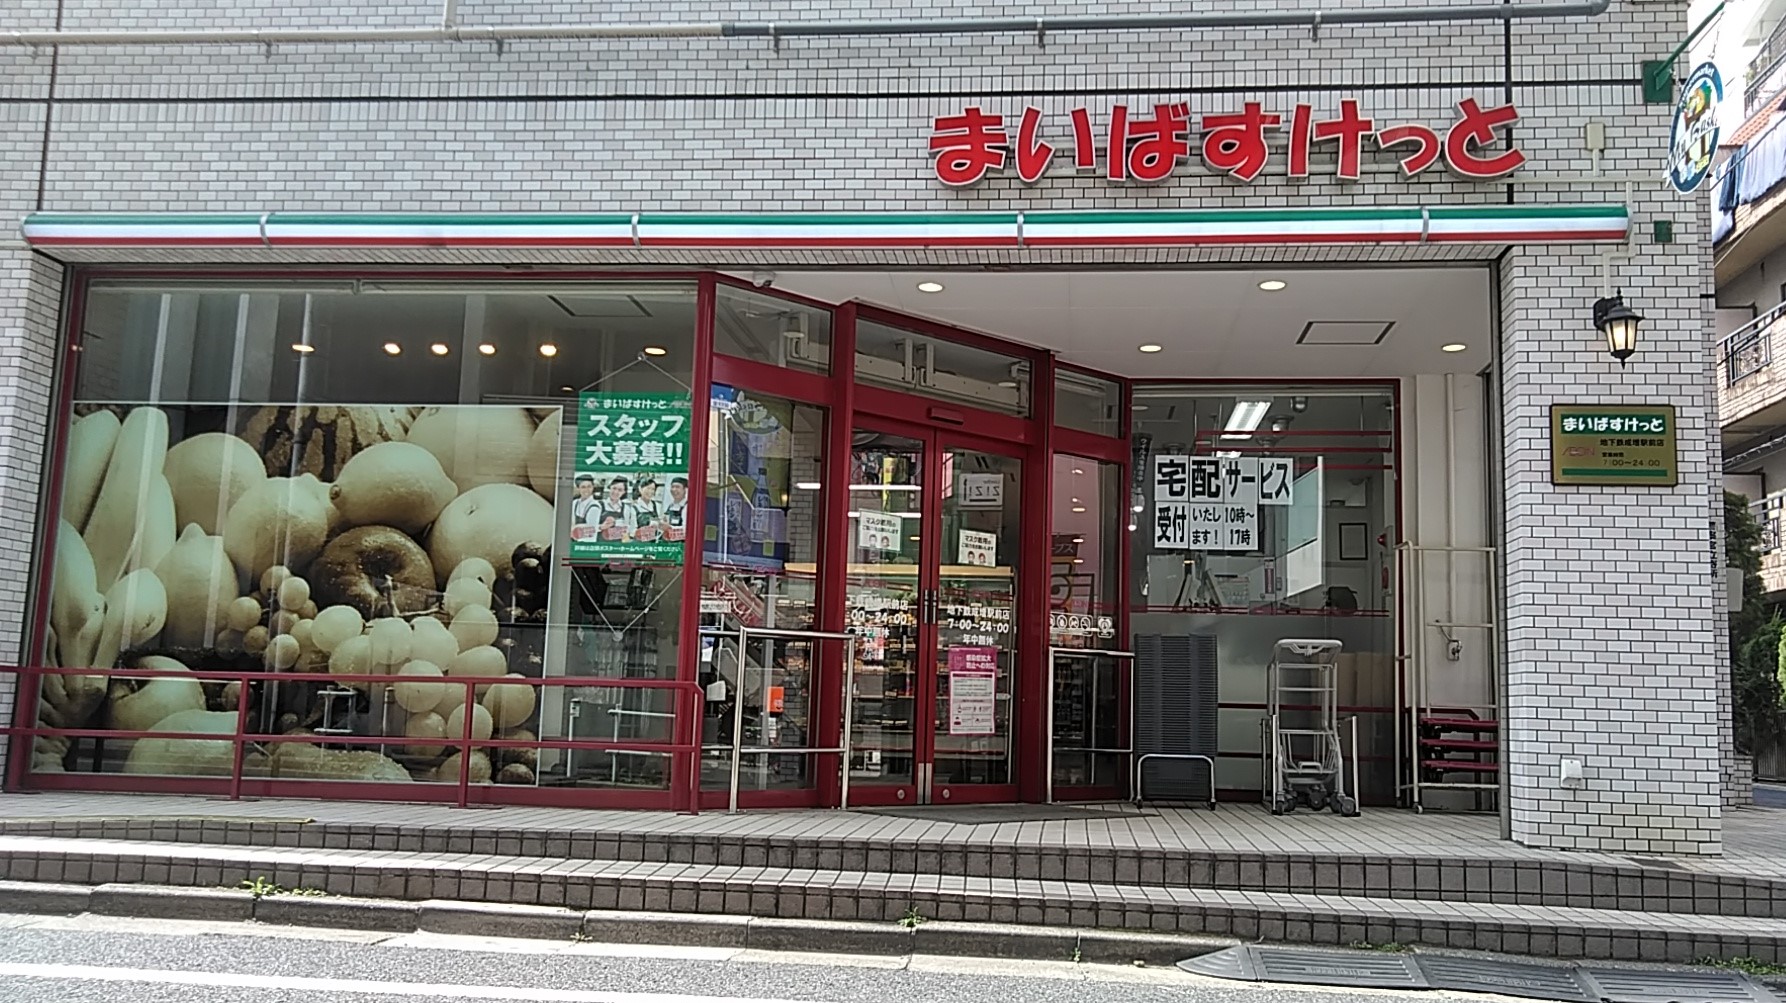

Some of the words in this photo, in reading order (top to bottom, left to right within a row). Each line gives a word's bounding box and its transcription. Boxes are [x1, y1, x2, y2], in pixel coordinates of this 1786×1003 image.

[929, 98, 1524, 187] まいばすけっと
[603, 399, 667, 409] まいばすけっと
[587, 413, 685, 438] スタッフ
[1562, 417, 1664, 432] まいばすけっと
[1600, 439, 1664, 447] 地下鉄成増駅前店
[584, 441, 683, 466] 大募集!!
[1156, 459, 1290, 499] 宅配サービス
[1157, 506, 1186, 543] 受付
[1192, 507, 1221, 522] いたし
[1230, 529, 1250, 545] 17時
[947, 605, 1010, 620] 地下鉄成増駅前店
[948, 619, 1009, 633] 7:00～24:00
[963, 634, 994, 646] 年中無休
